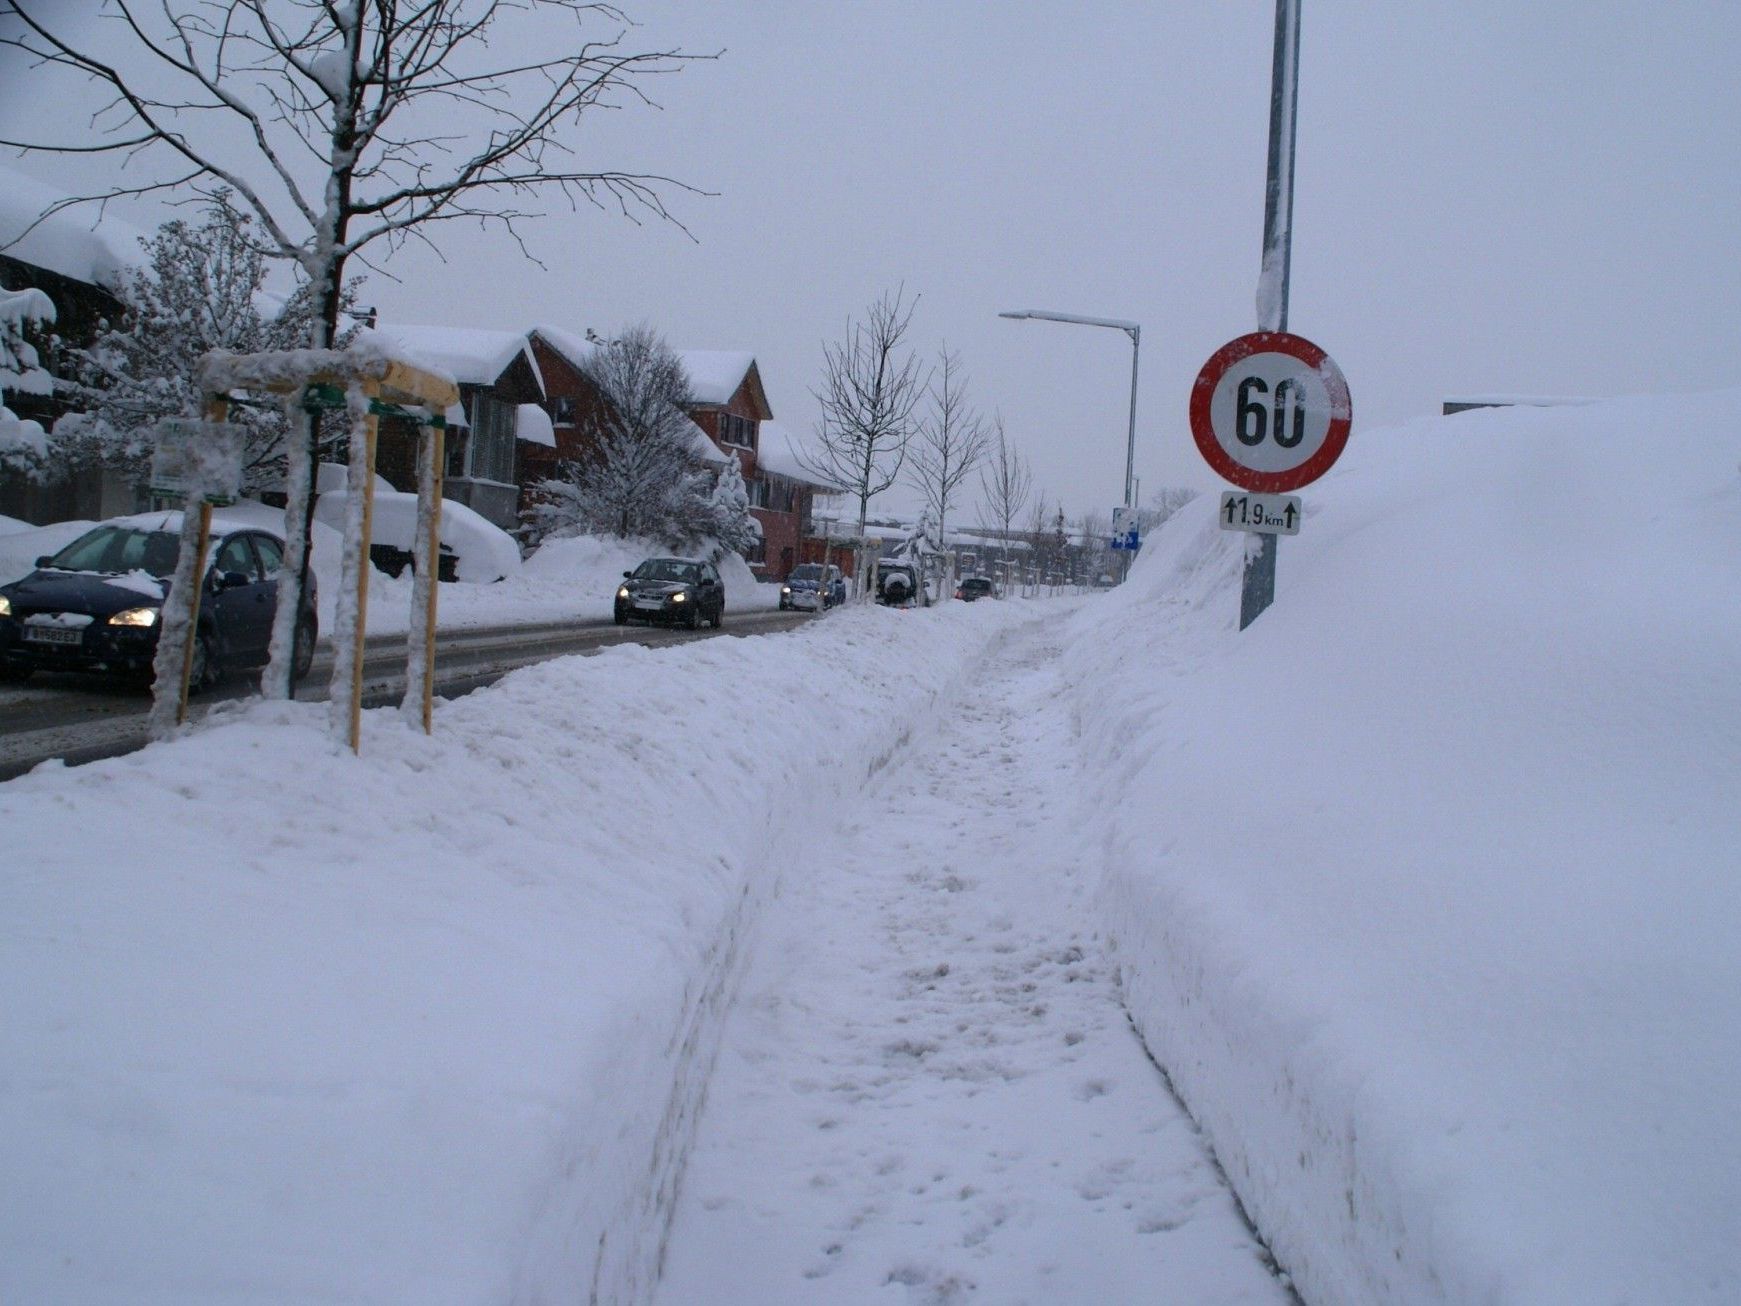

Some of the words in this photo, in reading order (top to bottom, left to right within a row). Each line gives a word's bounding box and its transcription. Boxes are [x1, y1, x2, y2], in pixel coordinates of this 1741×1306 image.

[1236, 376, 1305, 448] 60
[1238, 497, 1263, 526] 1,9
[1265, 515, 1283, 526] km
